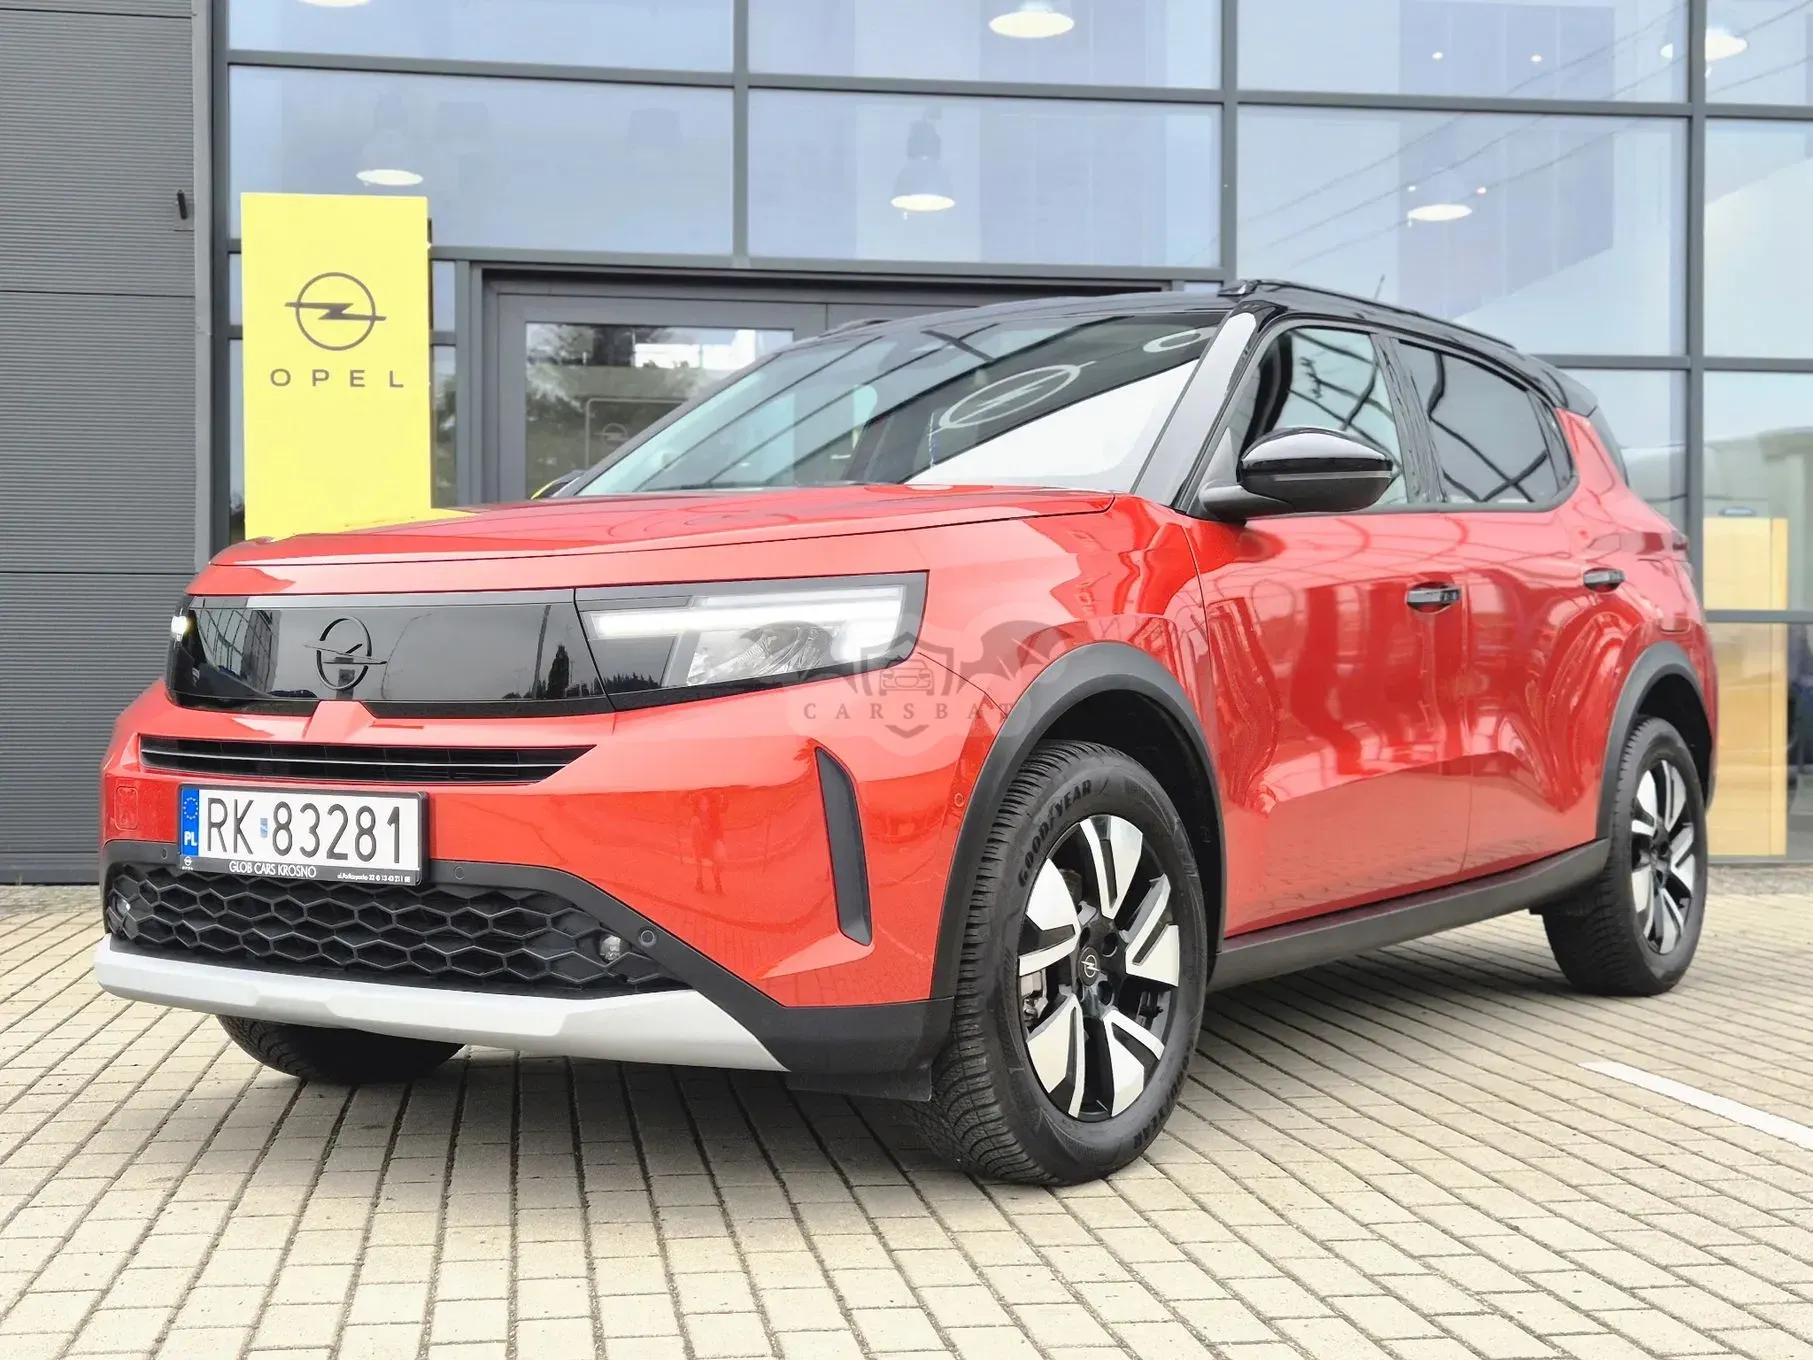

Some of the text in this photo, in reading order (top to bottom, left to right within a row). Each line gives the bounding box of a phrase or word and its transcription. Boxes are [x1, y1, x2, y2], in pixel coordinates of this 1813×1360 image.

[270, 368, 404, 388] OPEL
[183, 831, 198, 846] PL
[207, 797, 400, 864] RK 83281
[229, 861, 317, 878] GLOB CARS KROSNO
